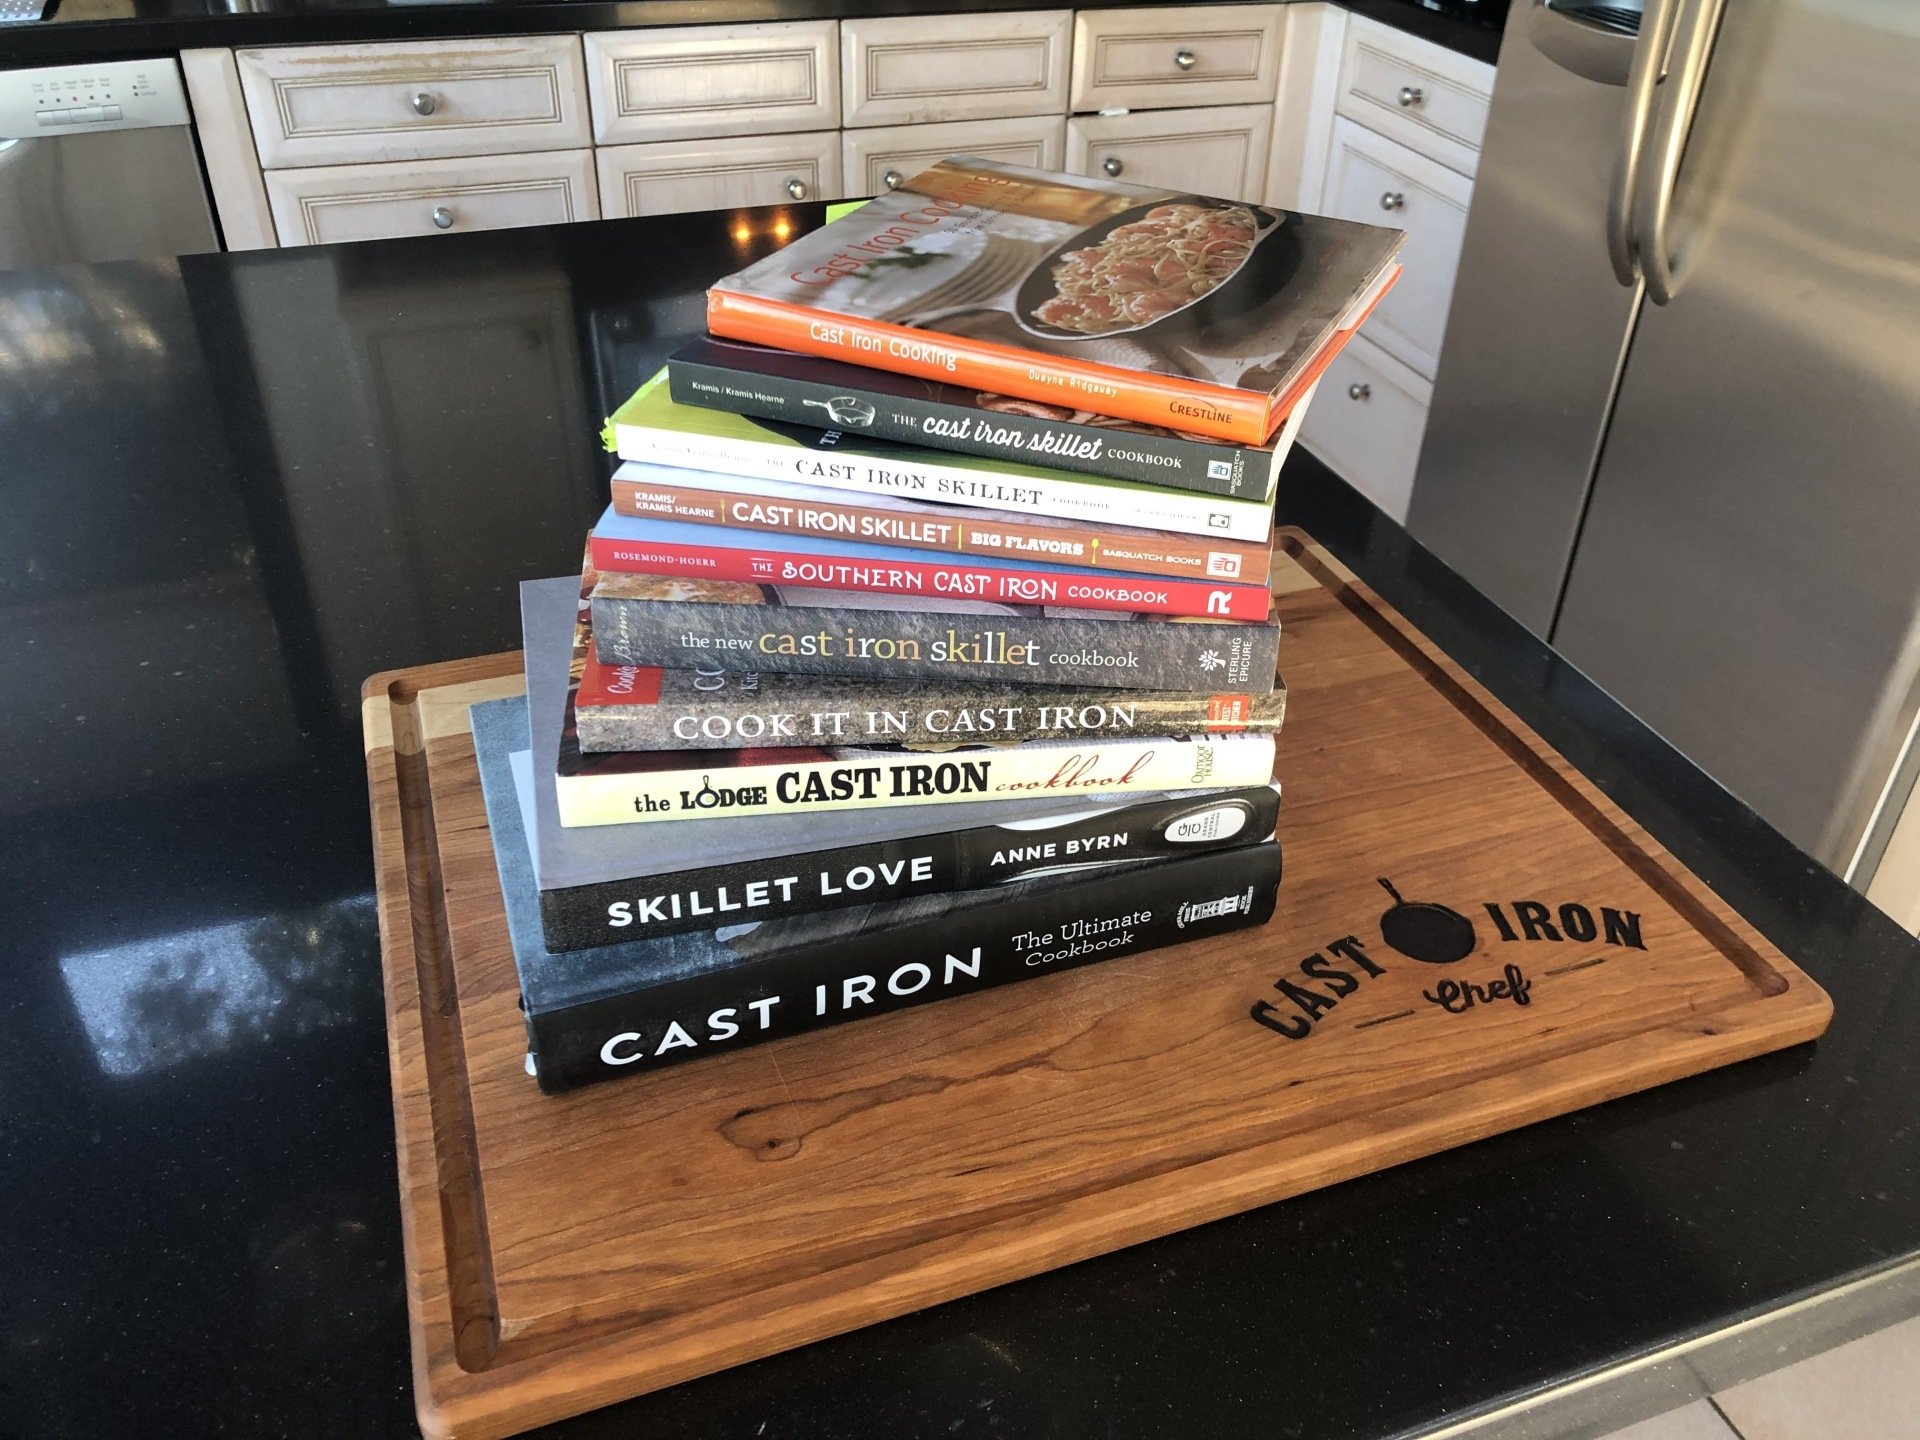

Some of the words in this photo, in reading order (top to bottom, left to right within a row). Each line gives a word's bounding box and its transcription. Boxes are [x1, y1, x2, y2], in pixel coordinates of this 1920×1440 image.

[790, 252, 864, 286] Cast
[847, 225, 919, 254] Iron
[900, 175, 1010, 226] Cooking
[809, 321, 845, 346] Cast
[851, 329, 882, 353] Iron
[889, 336, 957, 372] Cooking
[691, 380, 720, 394] Kramis
[725, 387, 754, 400] Kramis
[754, 391, 785, 405] Hearne
[1028, 368, 1064, 387] Dwayne
[1069, 375, 1118, 398] Ridgaway
[819, 430, 842, 445] TH
[891, 413, 918, 427] THE
[922, 415, 971, 440] cast
[973, 418, 1026, 450] iron
[1026, 431, 1104, 461] skillet
[1107, 448, 1183, 469] COOKBOOK
[795, 459, 856, 481] CAST
[867, 468, 926, 490] IRON
[938, 478, 1043, 505] SKILLET
[1229, 450, 1241, 494] SASQUATCH
[1236, 460, 1245, 487] BOOKS
[634, 491, 677, 505] KRAMIS/
[635, 501, 673, 514] KRAMIS
[675, 505, 715, 519] HEARNE
[732, 502, 793, 526] CAST
[797, 509, 857, 534] IRON
[861, 516, 952, 544] SKILLET
[970, 531, 1002, 547] BIG
[1005, 533, 1084, 556] FLAVORS
[1103, 548, 1163, 562] SASQUATCH
[1165, 555, 1202, 566] BOOKS
[751, 561, 774, 573] THE
[781, 560, 923, 590] SOUTHERN
[933, 571, 991, 595] CAST
[999, 577, 1057, 601] IRON
[1068, 585, 1168, 605] COOKBOOK
[681, 631, 710, 649] the
[715, 637, 754, 651] new
[759, 630, 834, 657] cast
[845, 628, 922, 660] iron
[930, 629, 1041, 667] skillet
[1049, 649, 1140, 668] cookbook
[1228, 637, 1242, 684] STERLING
[1239, 640, 1252, 683] EPICURE
[673, 714, 796, 740] COOK
[810, 711, 850, 736] IT
[865, 710, 909, 735] IN
[925, 707, 1023, 733] CAST
[1037, 704, 1136, 730] IRON
[634, 793, 671, 813] the
[680, 781, 768, 810] LODGE
[776, 767, 881, 804] CAST
[889, 760, 992, 797] IRON
[995, 750, 1155, 793] cookbook
[990, 843, 1057, 867] ANNE
[1066, 832, 1129, 856] BYRN
[607, 876, 799, 928] SKILLET
[820, 855, 934, 897] LOVE
[1011, 931, 1054, 952] The
[1060, 910, 1153, 941] Ultimate
[1025, 930, 1135, 967] Cookbook
[1249, 935, 1388, 1040] CAST
[1483, 900, 1649, 952] IRON
[600, 995, 781, 1066] CAST
[815, 946, 982, 1017] IRON
